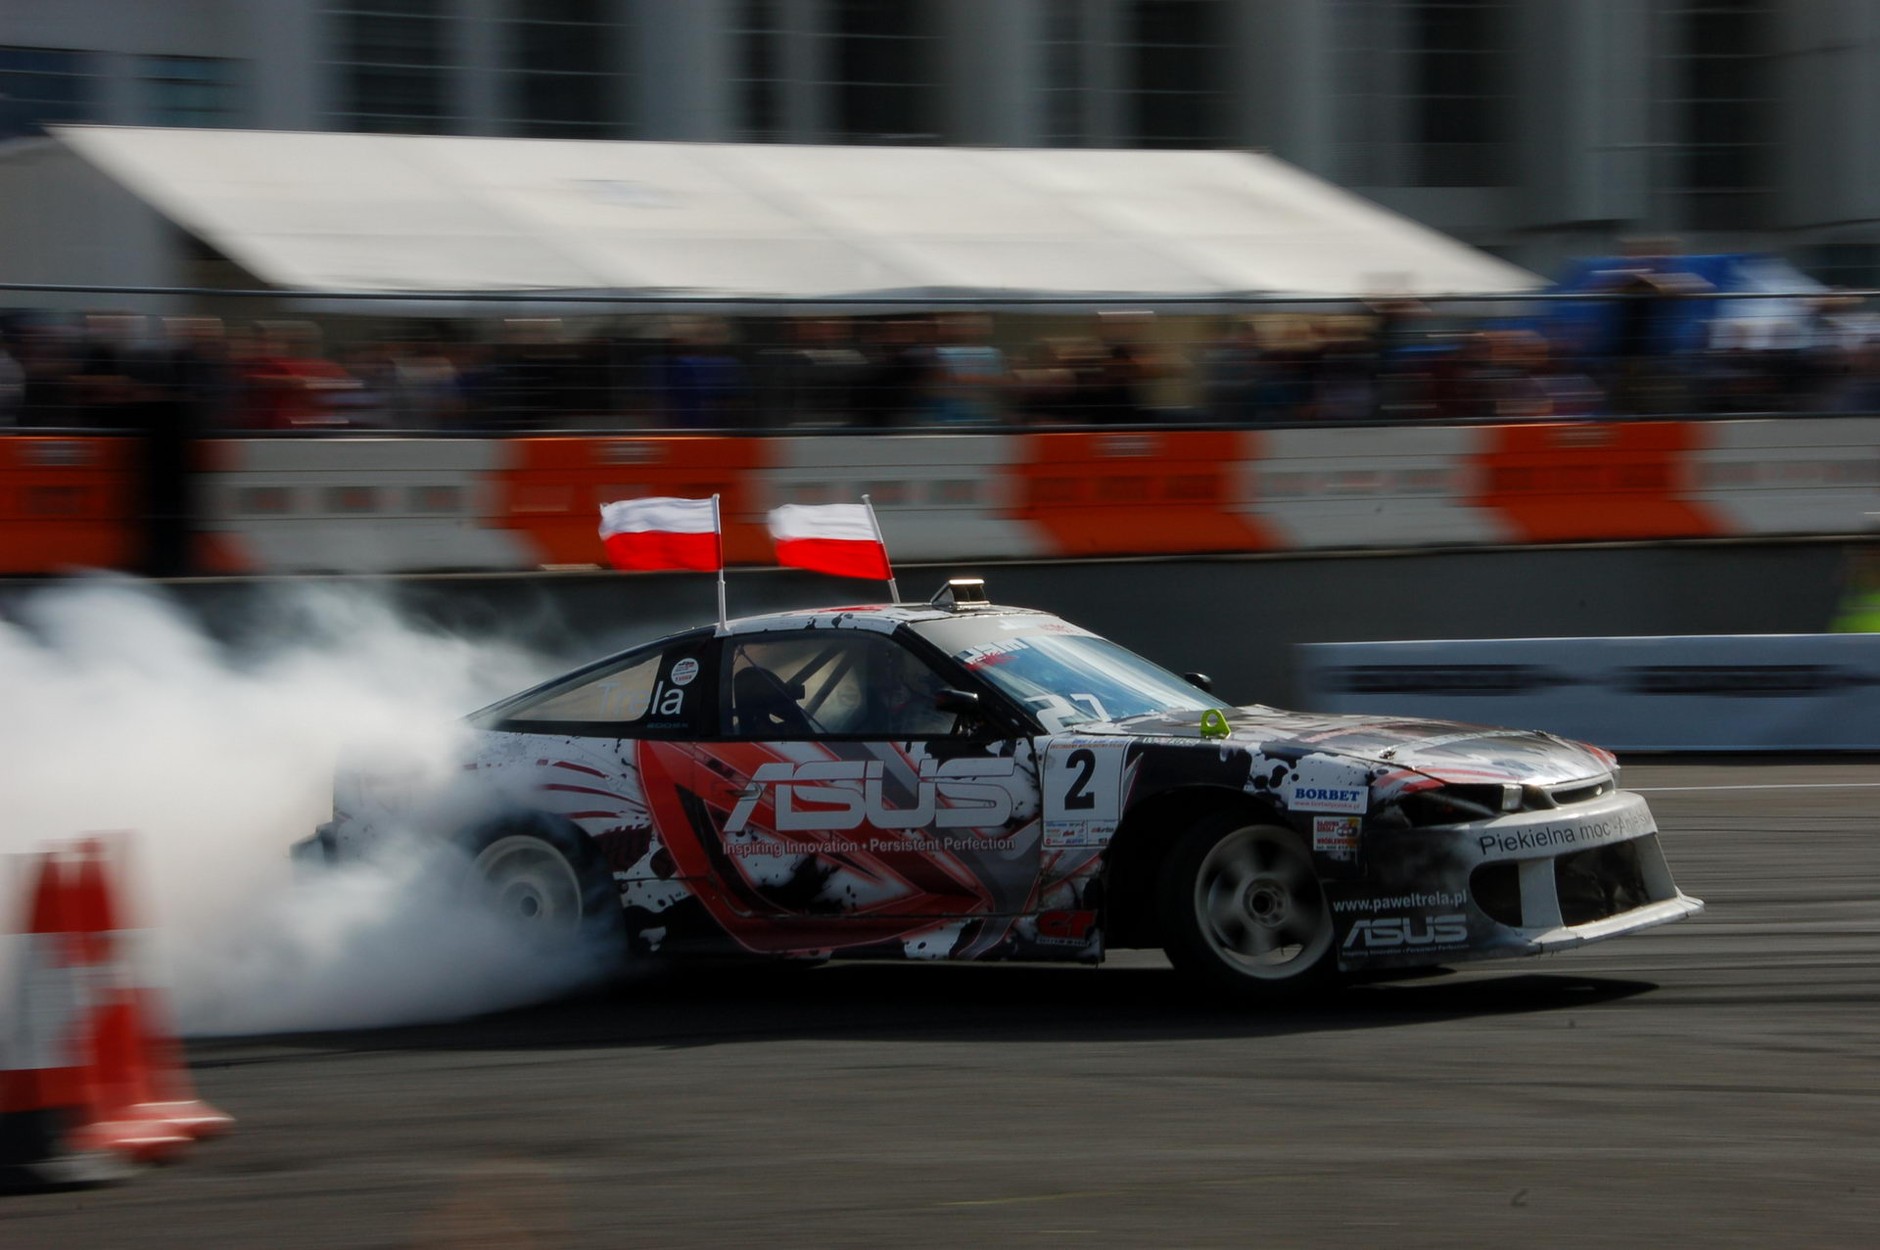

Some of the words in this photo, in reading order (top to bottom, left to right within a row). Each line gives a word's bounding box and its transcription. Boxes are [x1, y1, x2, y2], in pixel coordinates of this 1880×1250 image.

[723, 757, 1015, 832] ASUS
[1064, 749, 1096, 811] 2
[1295, 788, 1360, 802] BORBET
[722, 841, 783, 858] Inspiring
[785, 840, 858, 854] Innovation
[869, 838, 940, 852] Persistent
[943, 837, 1016, 851] Perfection
[1479, 827, 1576, 856] Piekielna
[1579, 822, 1611, 841] moc
[1332, 889, 1467, 912] www.paweltrela.pl
[1342, 914, 1468, 948] ASUS
